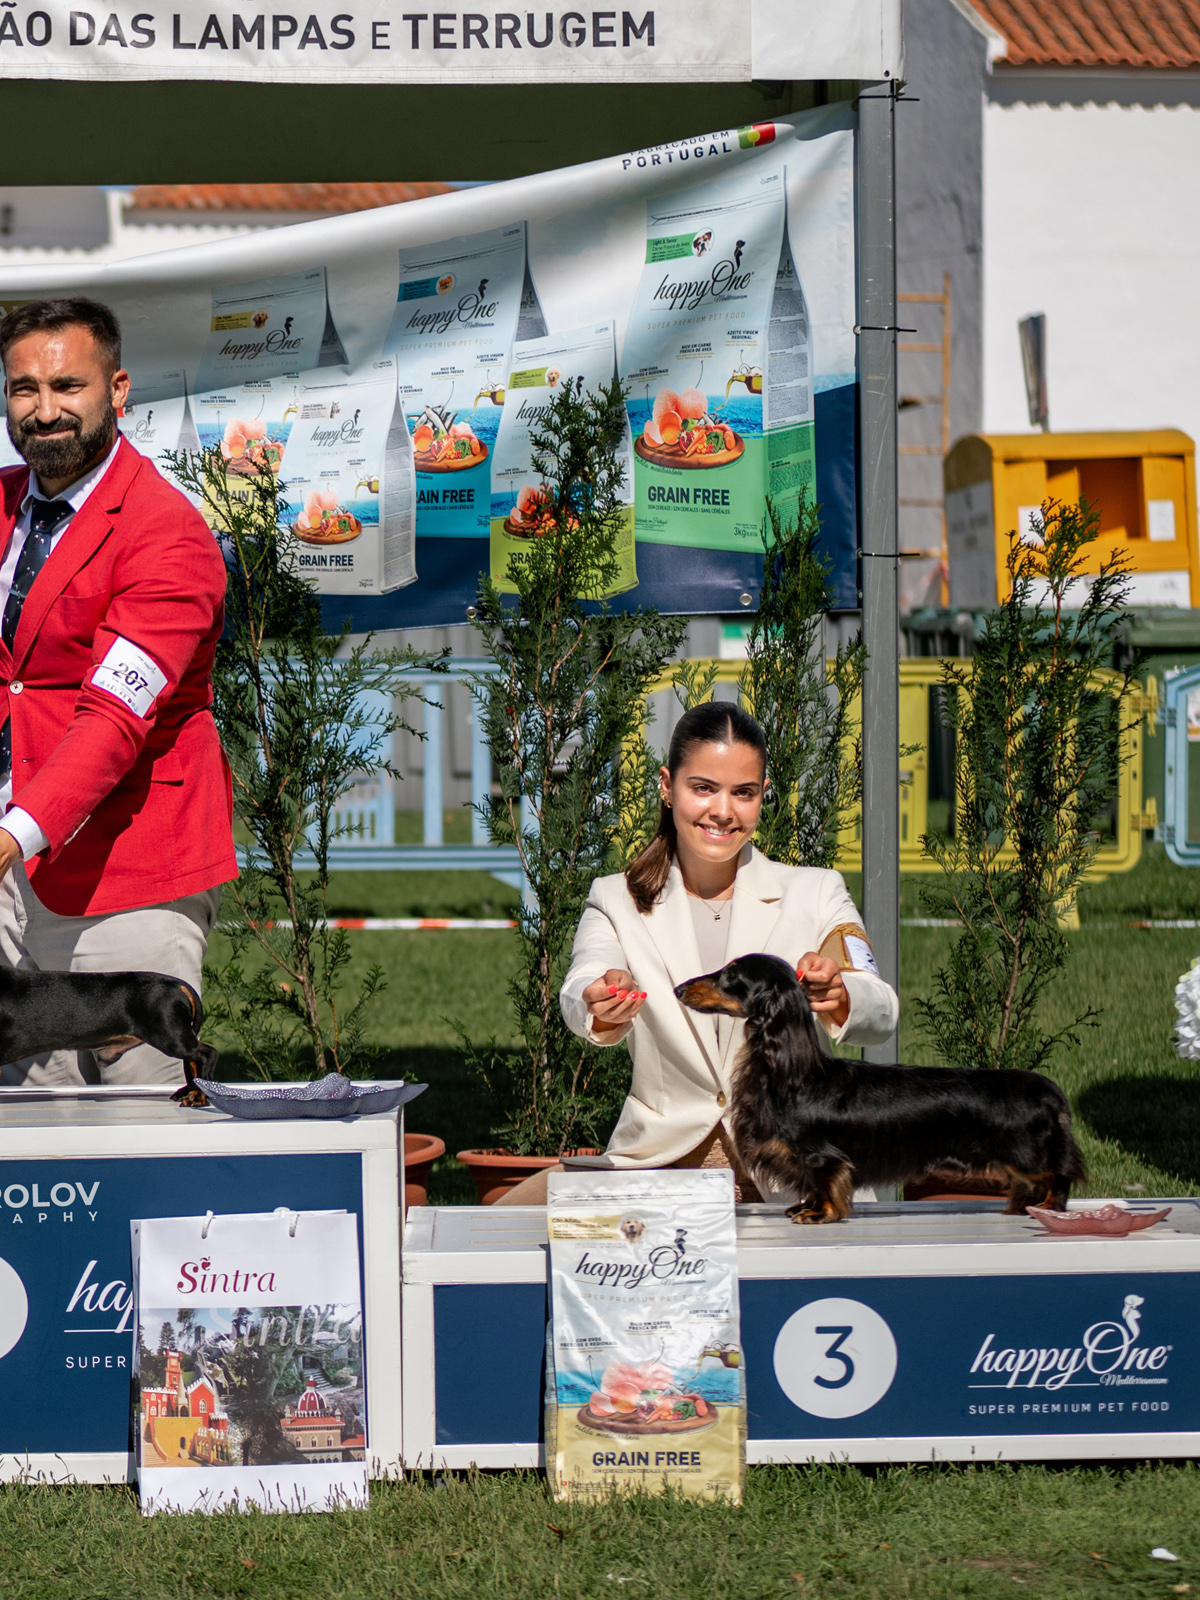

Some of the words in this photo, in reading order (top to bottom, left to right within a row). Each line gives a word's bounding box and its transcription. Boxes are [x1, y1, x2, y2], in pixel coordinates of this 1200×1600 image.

[69, 11, 156, 49] DAS
[172, 13, 356, 50] LAMPAS
[371, 21, 391, 50] E
[402, 10, 656, 50] TERRUGEM
[712, 130, 730, 141] EM
[622, 142, 733, 170] PORTUGAL
[653, 260, 751, 311] happyOne
[405, 292, 498, 335] happyOne
[647, 321, 671, 330] SUPER
[673, 315, 706, 328] PREMIUM
[709, 313, 723, 322] PET
[725, 311, 746, 320] FOOD
[219, 329, 302, 361] happyOne
[400, 343, 422, 351] SUPER
[424, 341, 456, 349] PREMIUM
[459, 339, 472, 348] PET
[474, 338, 494, 346] FOOD
[310, 419, 363, 448] happyOne
[416, 490, 440, 504] AIN
[442, 488, 475, 503] FREE
[647, 485, 690, 504] GRAIN
[693, 487, 731, 507] FREE
[733, 526, 747, 539] 3kg
[298, 554, 327, 567] GRAIN
[329, 554, 354, 567] FREE
[112, 662, 149, 692] 207
[176, 1256, 277, 1294] Sintra
[574, 1245, 706, 1290] happyOne
[65, 1259, 134, 1334] hap
[609, 1295, 657, 1303] PREMIUM
[208, 1304, 363, 1350] Sintra
[65, 1356, 127, 1369] SUPER
[812, 1325, 855, 1390] 3
[969, 1321, 1169, 1391] happyOne
[1100, 1372, 1169, 1387] Mediterraneum
[968, 1403, 1016, 1415] SUPER
[1023, 1403, 1092, 1414] PREMIUM
[1098, 1402, 1125, 1413] PET
[1131, 1401, 1170, 1412] FOOD
[592, 1451, 650, 1467] GRAIN
[655, 1451, 702, 1466] FREE
